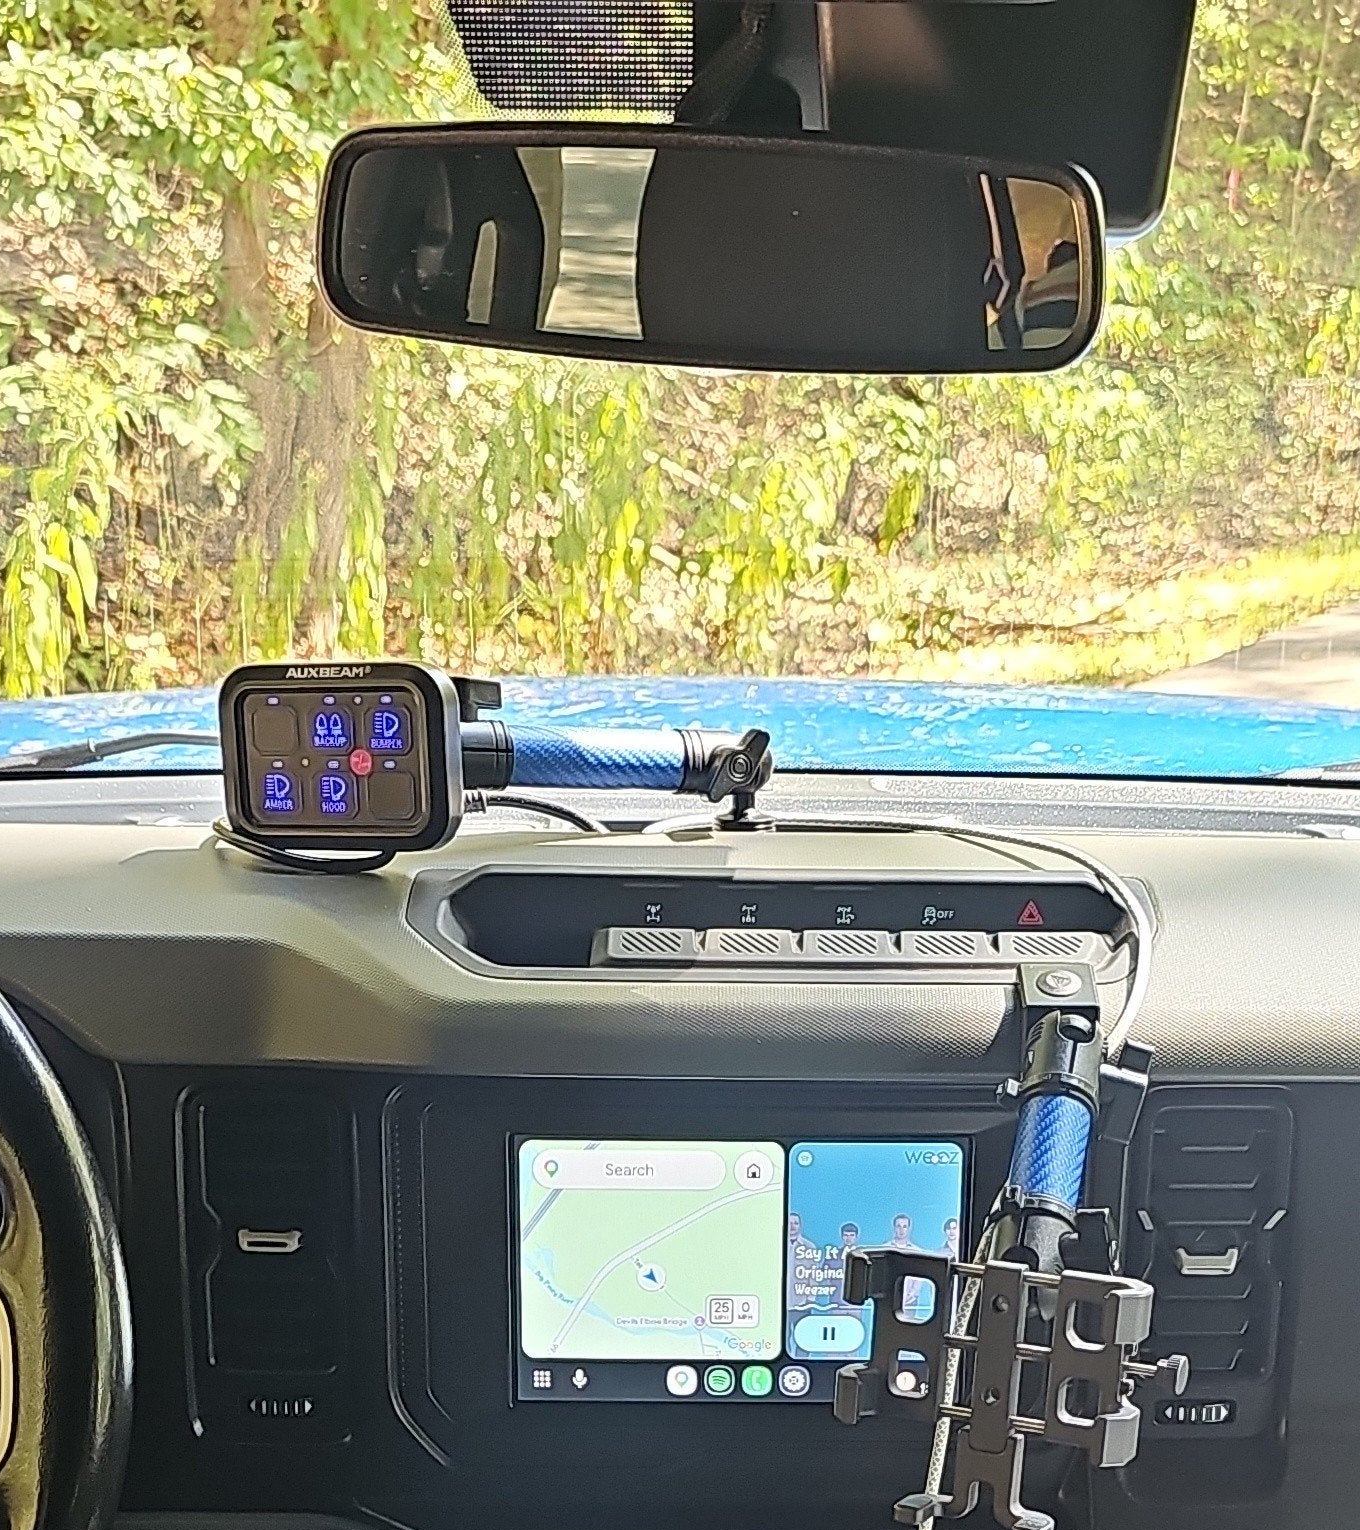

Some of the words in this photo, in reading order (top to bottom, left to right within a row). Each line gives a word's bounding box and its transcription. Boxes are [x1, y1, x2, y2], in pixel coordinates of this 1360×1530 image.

[322, 801, 346, 813] HOOD
[937, 910, 955, 919] OFF
[605, 1163, 654, 1177] Search
[795, 1245, 822, 1262] Say
[825, 1245, 839, 1260] It
[795, 1265, 844, 1282] Origina
[794, 1283, 837, 1296] Weezer
[713, 1301, 730, 1313] 25
[741, 1301, 751, 1313] 0
[727, 1337, 772, 1352] Google
